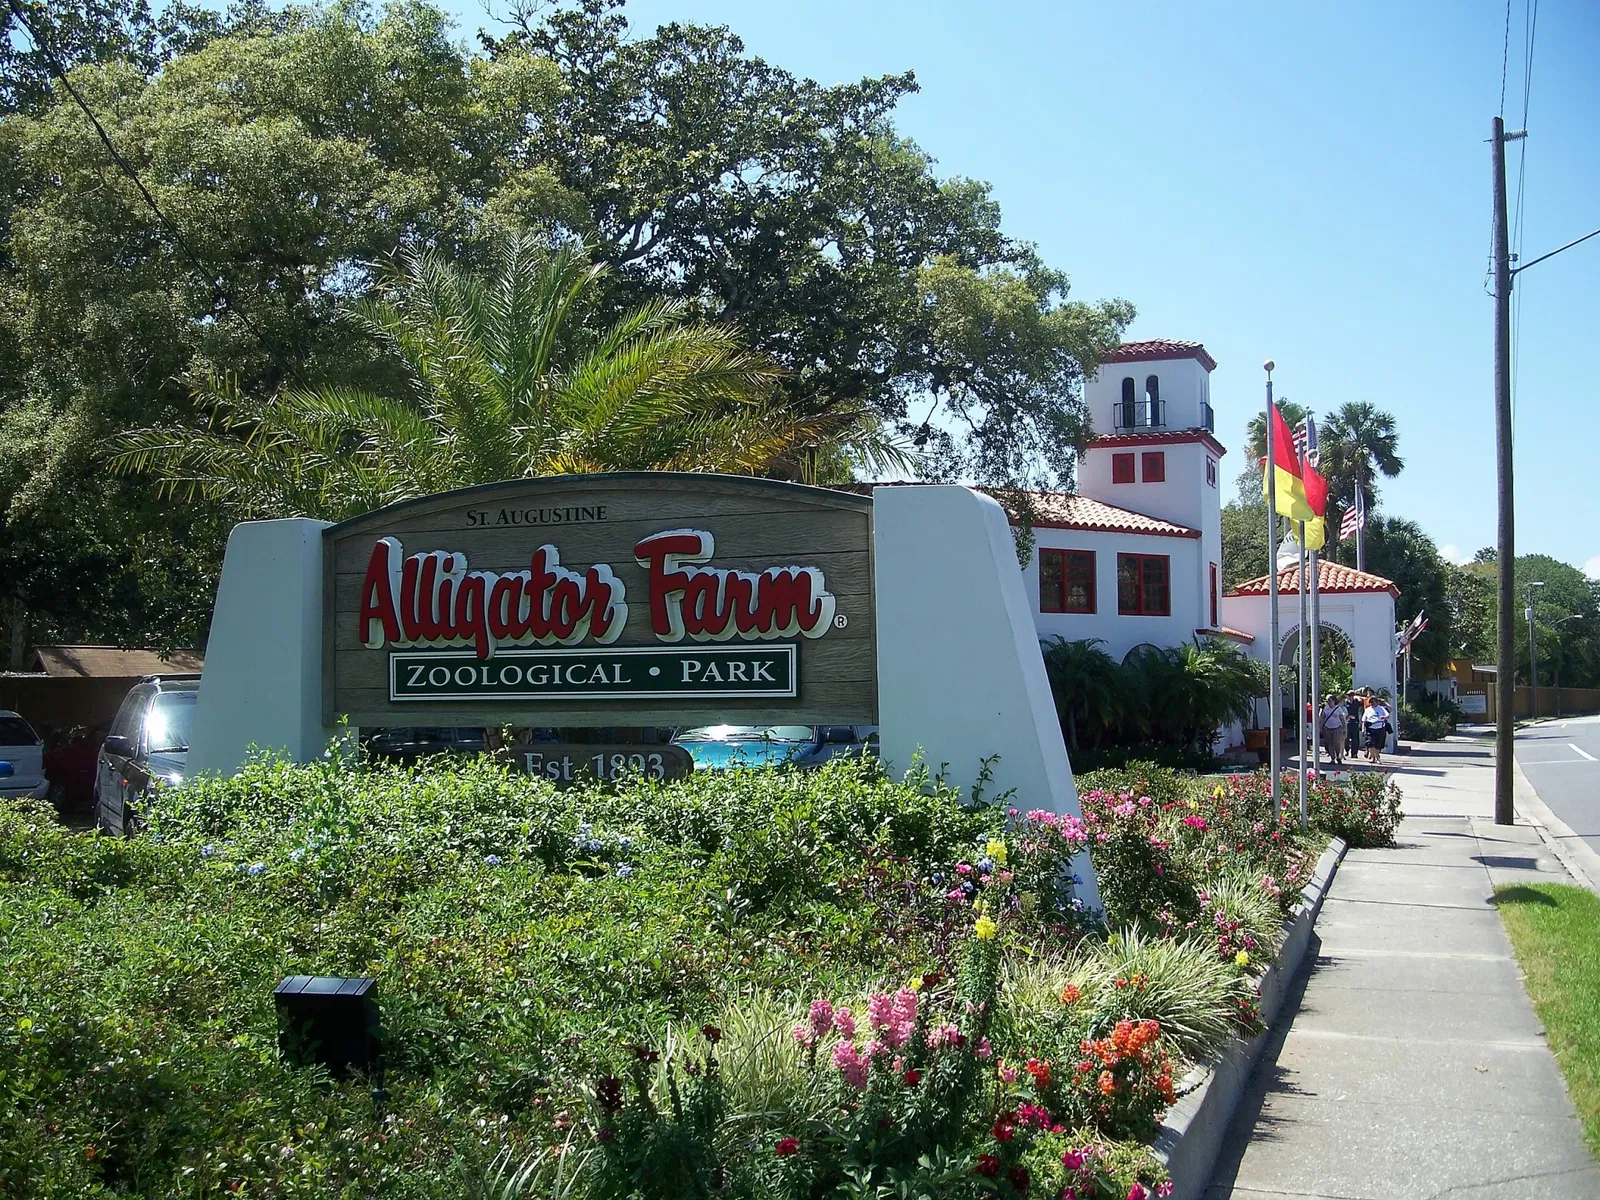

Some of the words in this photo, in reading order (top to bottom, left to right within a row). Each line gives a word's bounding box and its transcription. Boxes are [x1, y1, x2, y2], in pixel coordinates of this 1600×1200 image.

[465, 509, 490, 526] ST.
[495, 506, 608, 525] AUGUSTINE
[358, 536, 629, 660] Alligator
[633, 528, 836, 642] Farm
[406, 663, 632, 687] ZOOLOGICAL
[680, 660, 776, 683] PARK
[523, 752, 574, 781] Est
[591, 753, 665, 781] 1893
